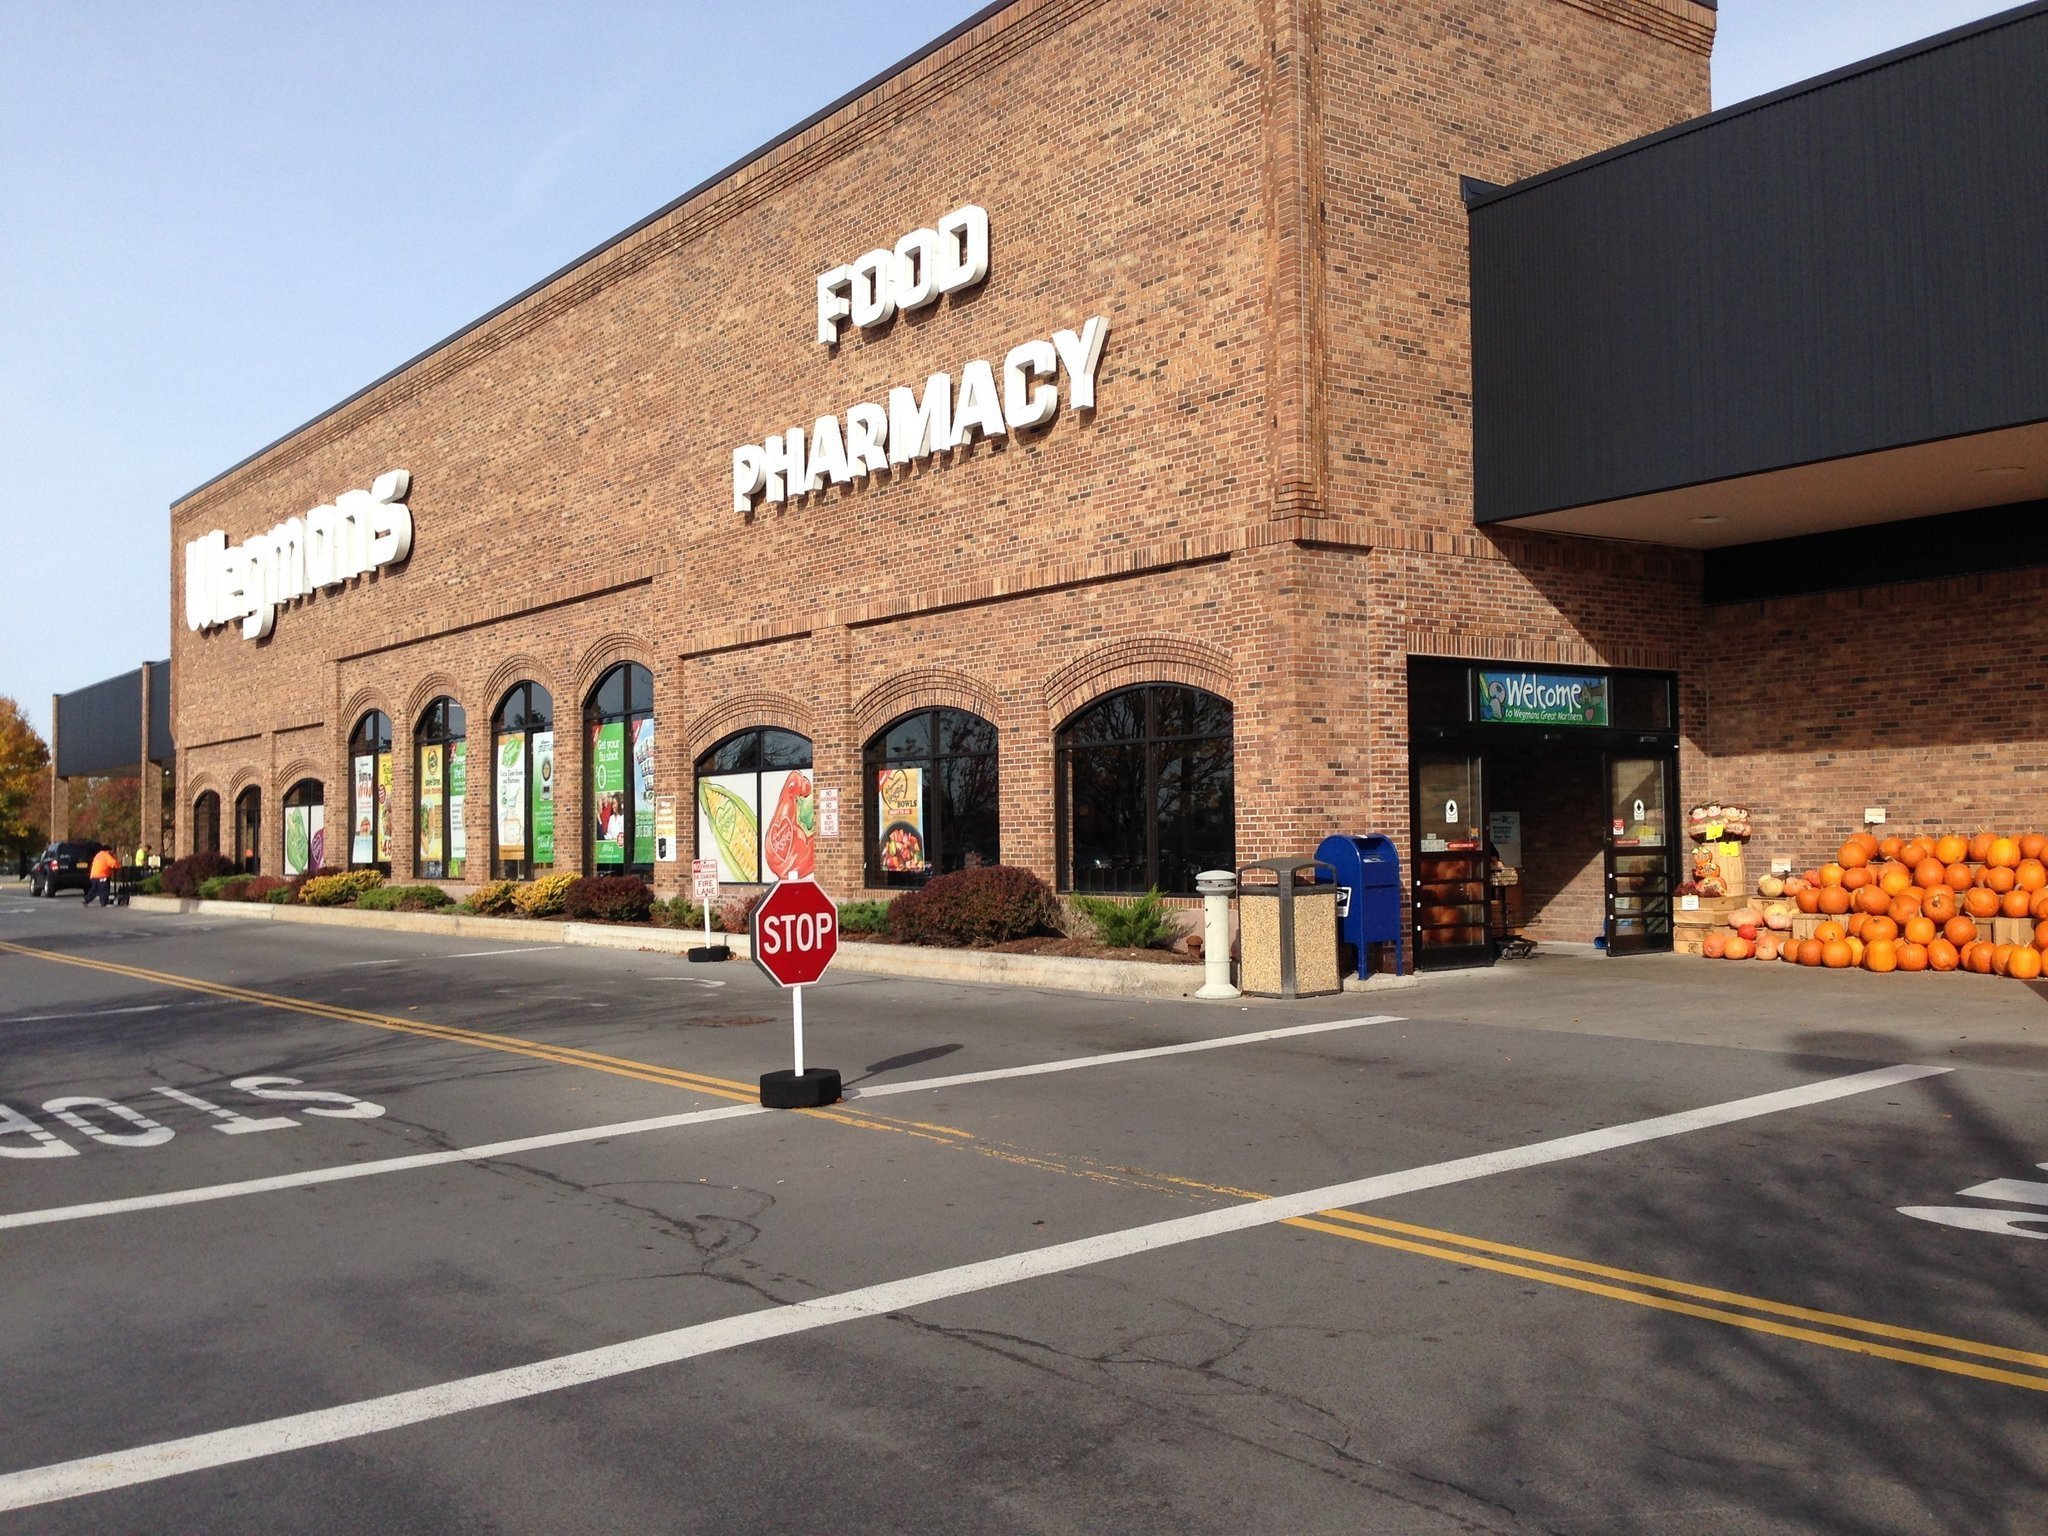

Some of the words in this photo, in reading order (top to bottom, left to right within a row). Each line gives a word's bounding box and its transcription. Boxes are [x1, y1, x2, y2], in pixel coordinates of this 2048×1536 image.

[817, 203, 989, 346] FOOD
[732, 314, 1110, 514] PHARMACY
[185, 468, 411, 641] Wegmans
[1505, 673, 1582, 713] Welcome
[1505, 709, 1512, 718] to
[1513, 709, 1540, 720] Wegmans
[1540, 710, 1557, 721] Great
[1557, 711, 1583, 721] Northern
[897, 800, 917, 808] BOWLS
[763, 912, 833, 954] STOP
